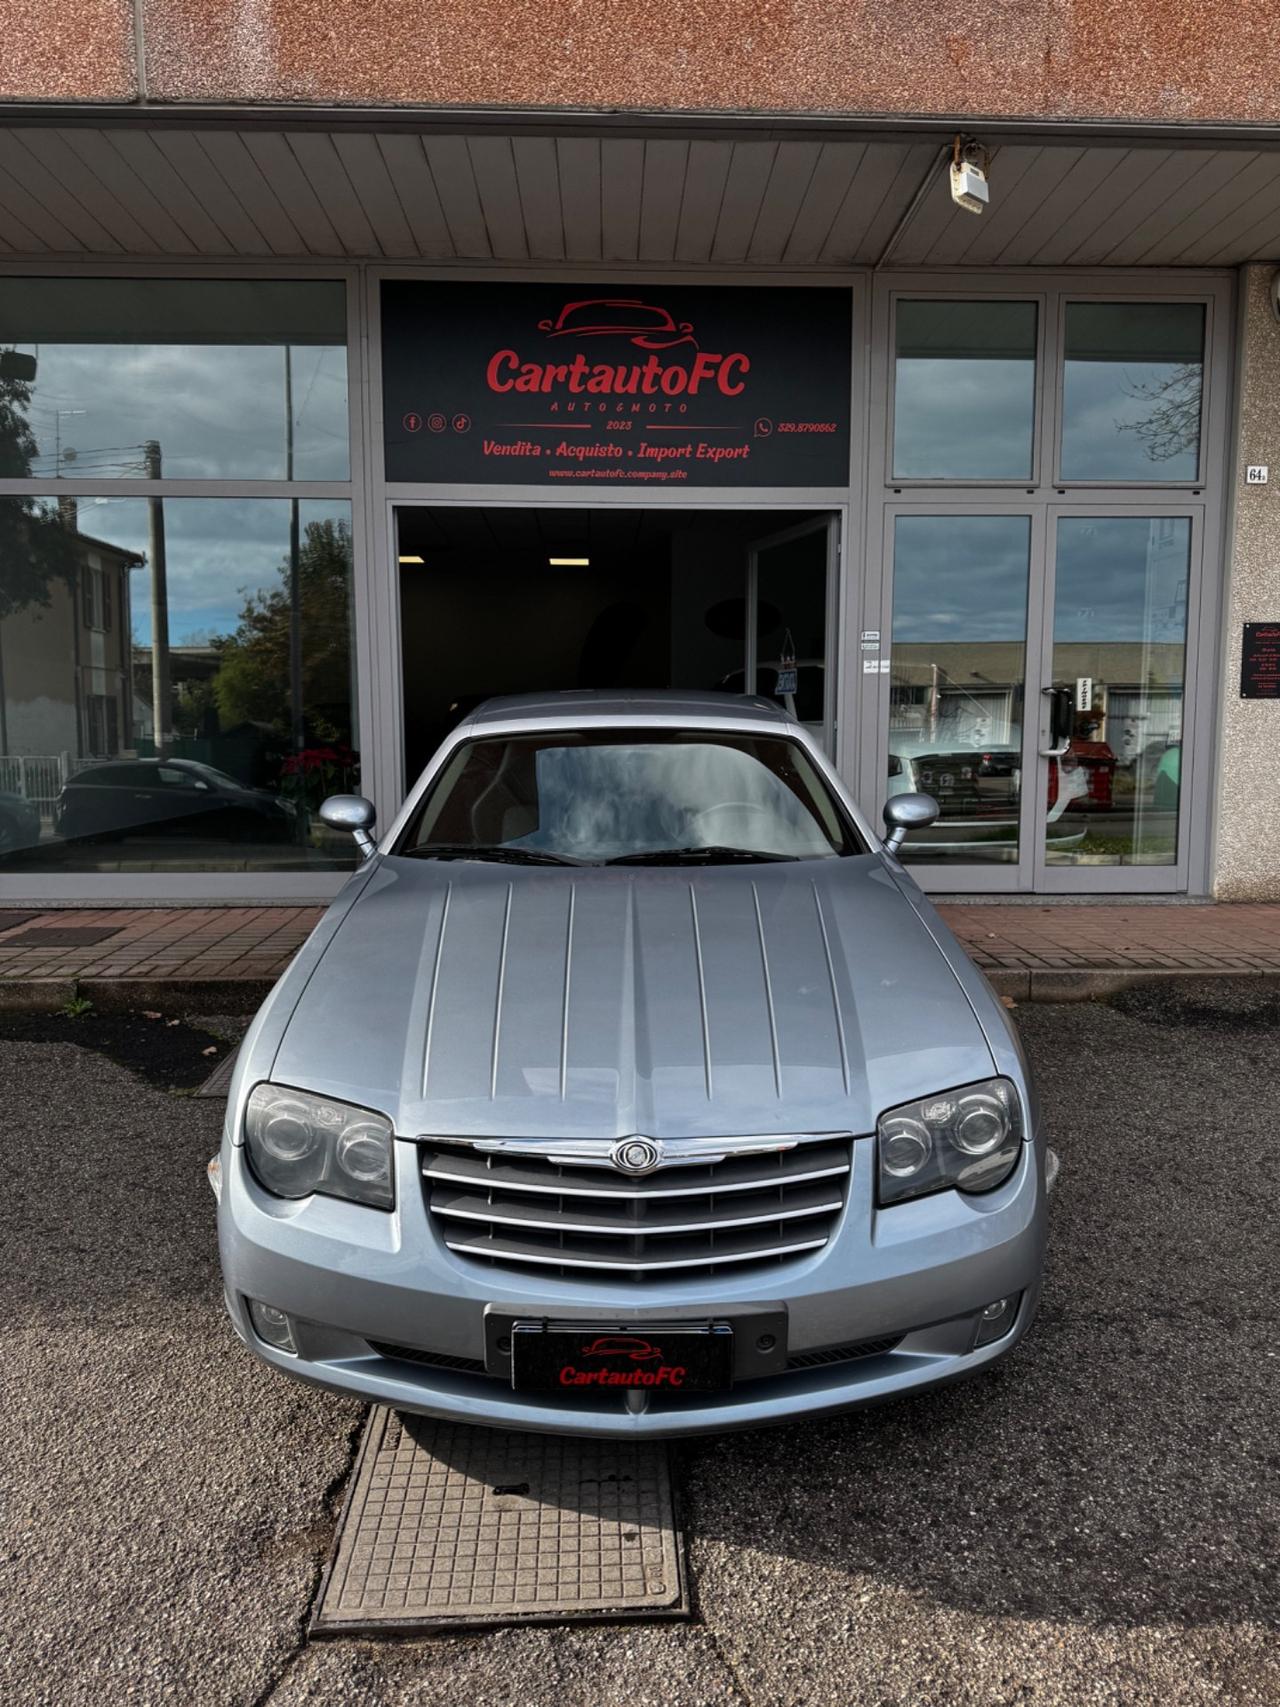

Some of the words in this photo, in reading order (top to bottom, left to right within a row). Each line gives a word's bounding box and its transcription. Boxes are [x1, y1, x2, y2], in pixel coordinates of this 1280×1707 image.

[486, 349, 751, 396] CartautoFC
[606, 420, 632, 431] 2023
[482, 440, 541, 457] Vendita
[555, 442, 623, 460] Acquisto
[637, 443, 692, 462] Import
[695, 443, 751, 461] Export
[559, 1366, 687, 1386] CartautoFC
